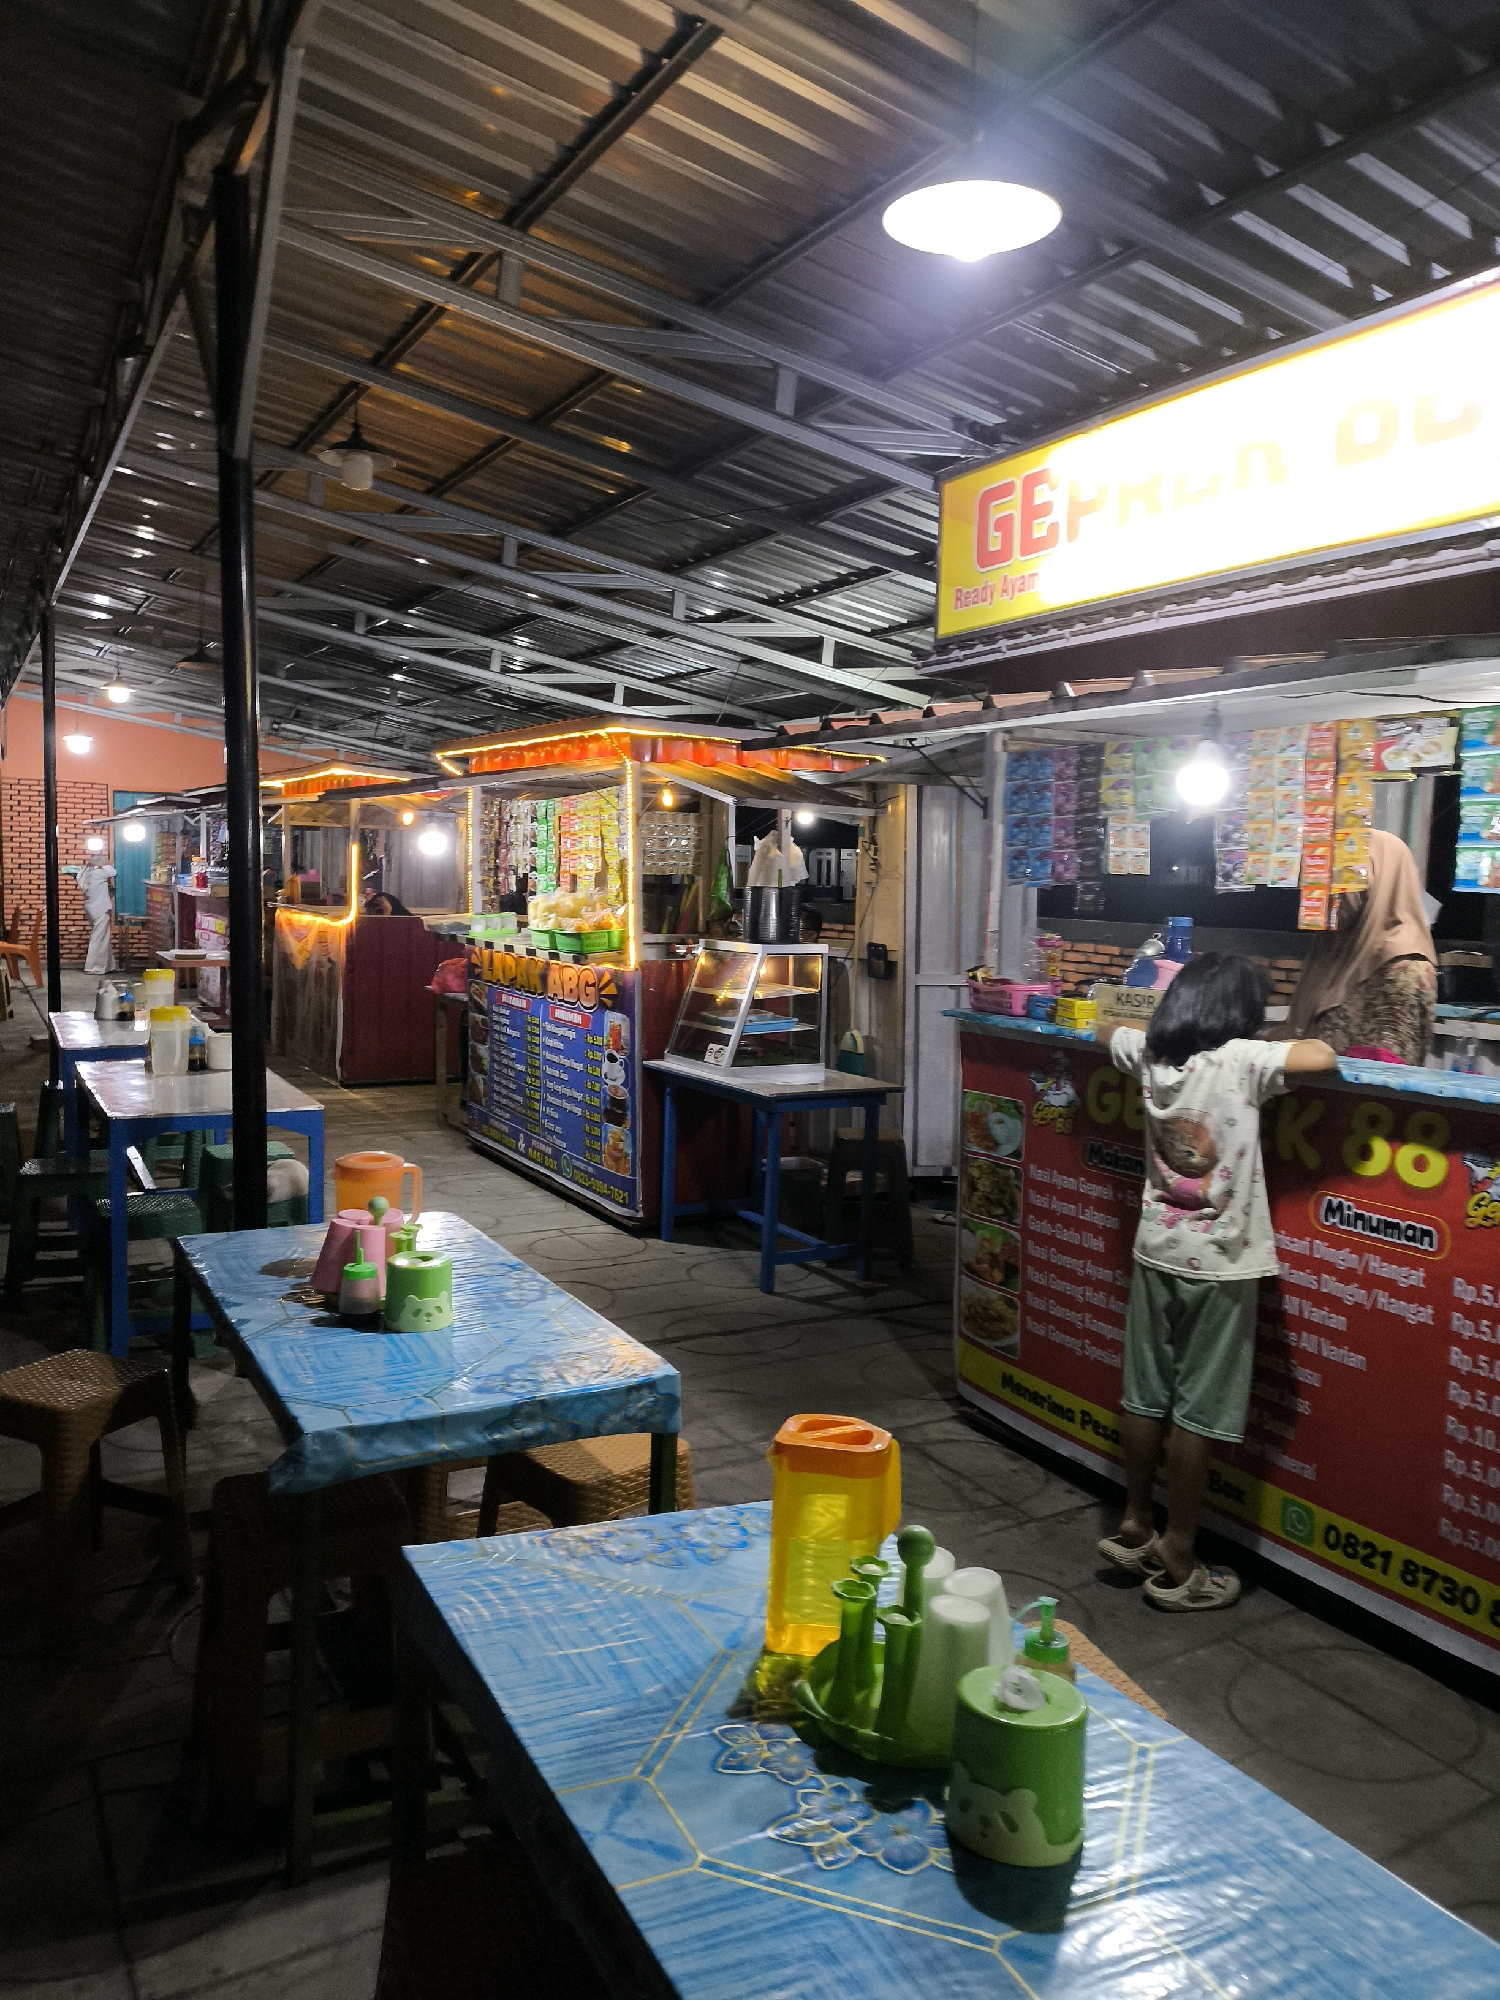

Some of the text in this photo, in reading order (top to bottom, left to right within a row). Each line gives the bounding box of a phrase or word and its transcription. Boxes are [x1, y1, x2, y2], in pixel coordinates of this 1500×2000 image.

[954, 580, 996, 609] Ready
[482, 949, 598, 1012] LAPAK ABG
[1341, 1100, 1450, 1190] 88
[1029, 1163, 1051, 1184] Nasi
[1050, 1169, 1078, 1191] Ayam
[1028, 1188, 1050, 1210] Nasi
[1050, 1195, 1077, 1217] Ayam
[1320, 1196, 1438, 1252] Minuman
[1026, 1239, 1048, 1261] Nasi
[1049, 1247, 1085, 1277] Goreng
[1085, 1259, 1113, 1282] Ayam
[1026, 1264, 1048, 1287] Nasi
[1048, 1273, 1084, 1304] Goreng
[1452, 1275, 1500, 1309] Rp.5.
[1025, 1289, 1047, 1313] Nasi
[1048, 1299, 1083, 1330] Goreng
[1301, 1300, 1347, 1332] Varian
[1025, 1315, 1046, 1338] Nasi
[1047, 1324, 1082, 1356] Goreng
[1319, 1337, 1367, 1371] Varian
[1001, 1371, 1121, 1446] Menerima Pesa
[1443, 1449, 1500, 1489] Rp.5.0
[1441, 1483, 1500, 1525] Rp.5.0
[1439, 1517, 1500, 1560] Rp.5.0
[1322, 1523, 1394, 1577] 0821
[1399, 1557, 1481, 1617] 8730
